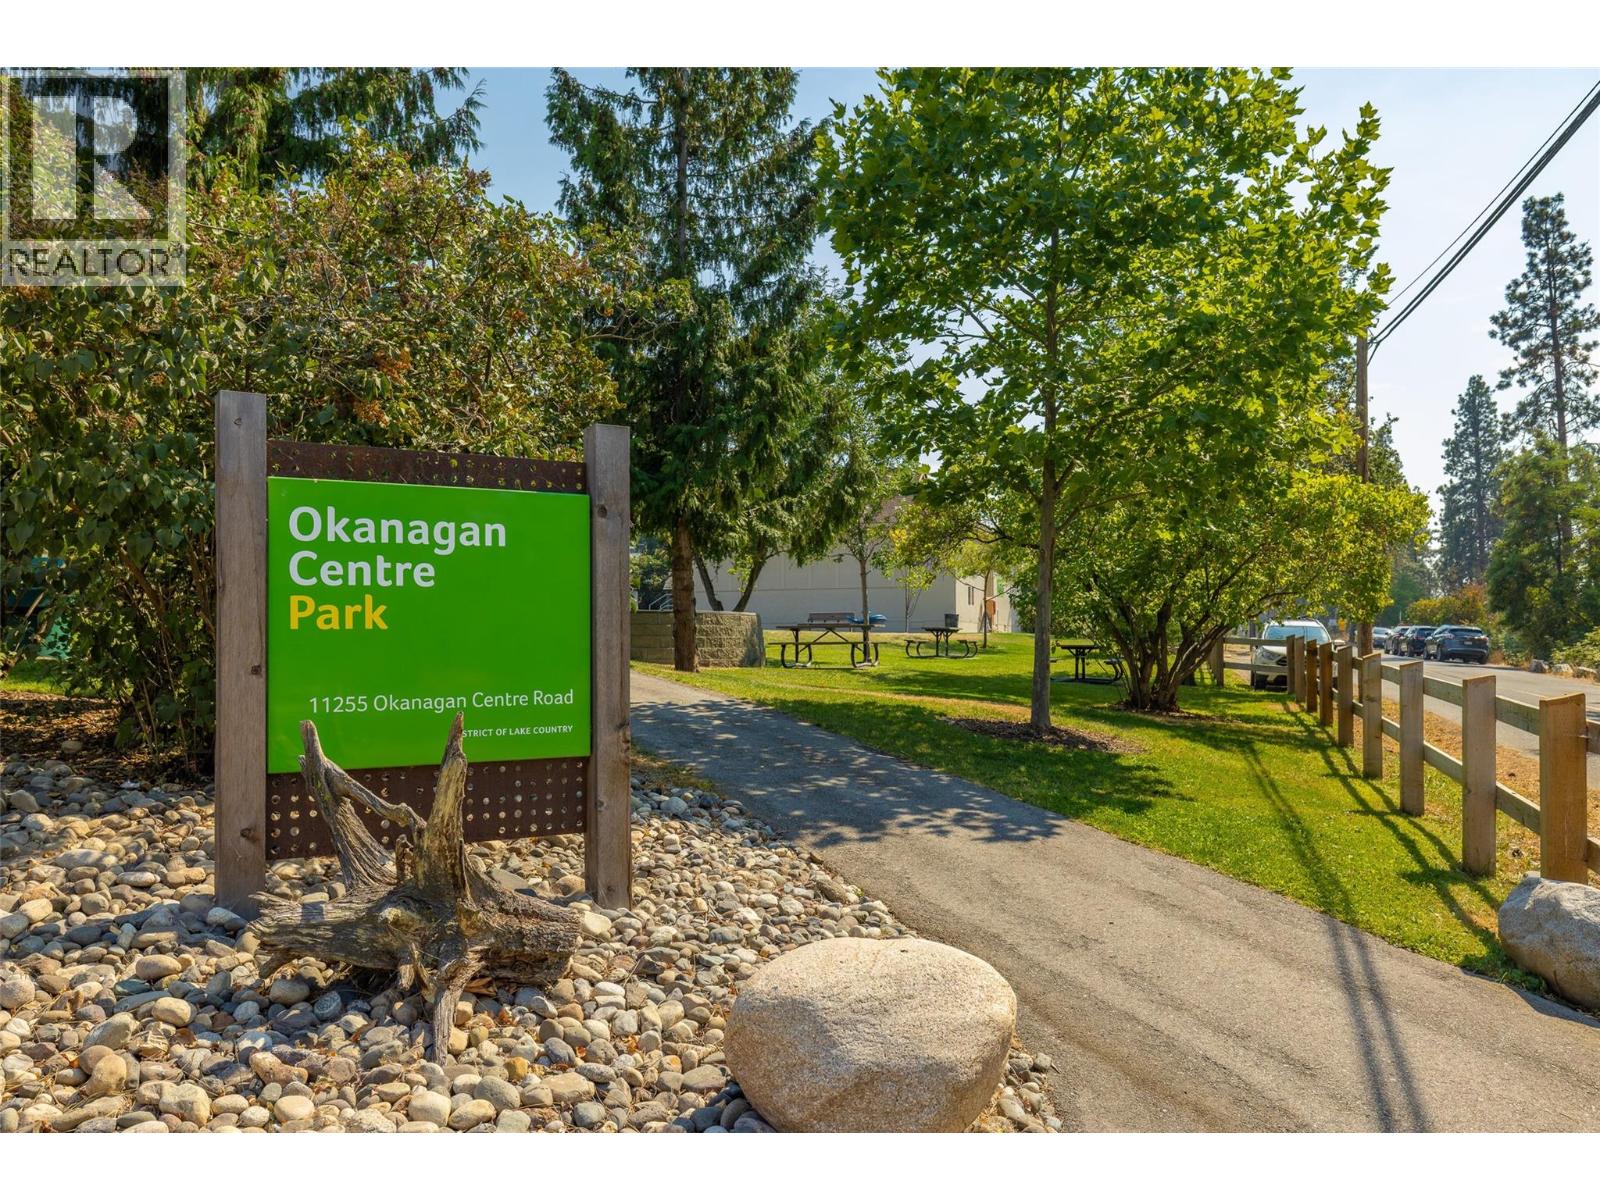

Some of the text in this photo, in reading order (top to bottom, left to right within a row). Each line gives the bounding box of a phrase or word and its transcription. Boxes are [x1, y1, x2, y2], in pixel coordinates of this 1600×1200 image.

[289, 505, 507, 556] Okanagan
[289, 550, 436, 588] Centre
[289, 594, 388, 630] Park
[309, 689, 574, 714] 11255 Okanagan Centre Road
[461, 725, 573, 738] STRICT OF LAKE COUNTRY
